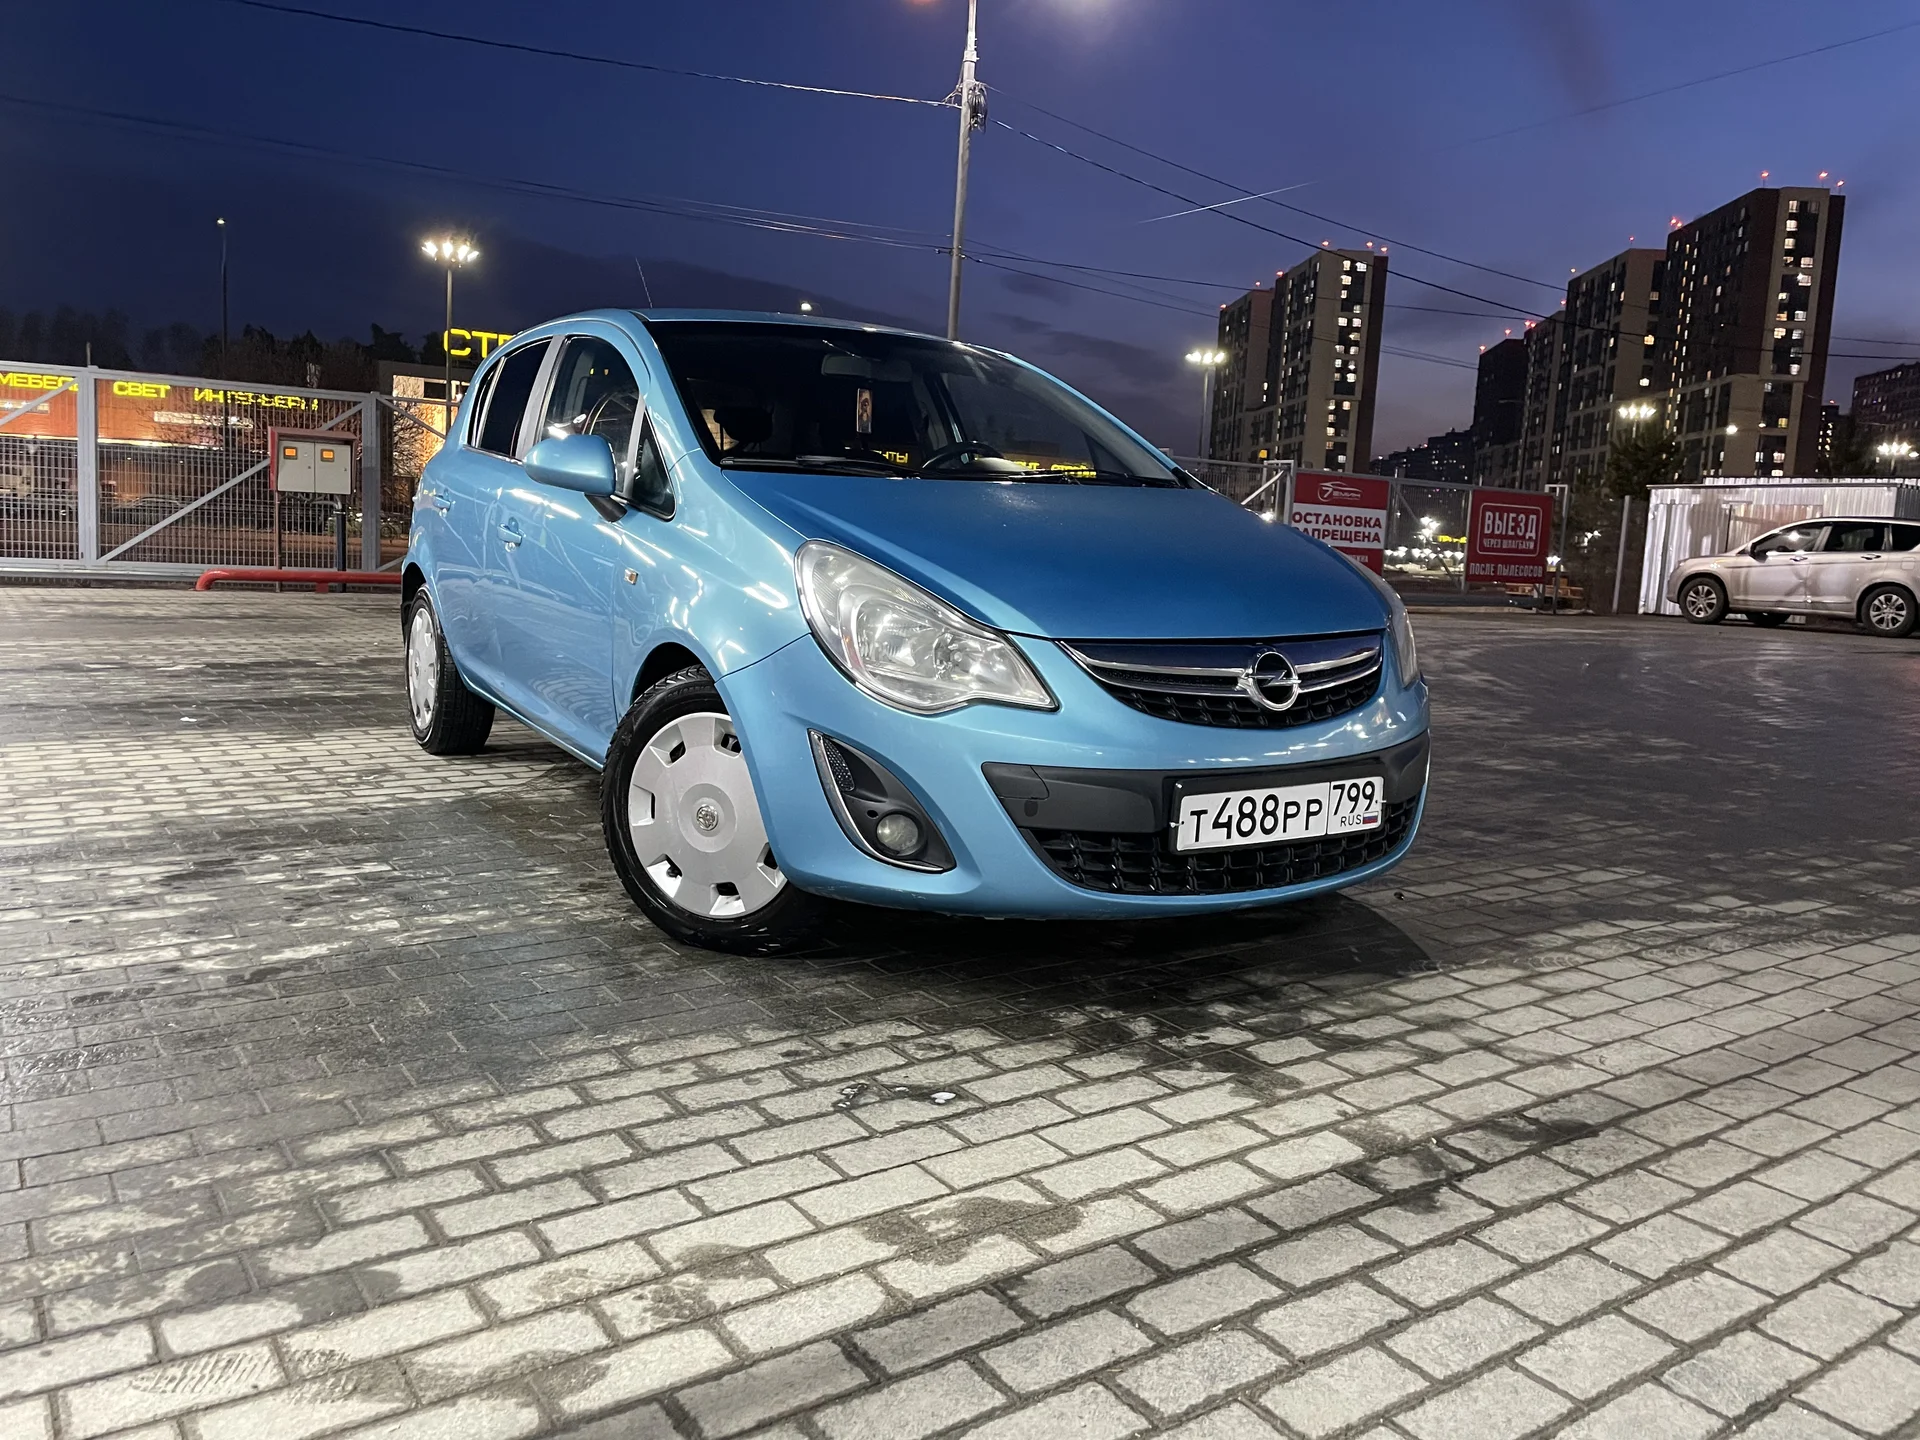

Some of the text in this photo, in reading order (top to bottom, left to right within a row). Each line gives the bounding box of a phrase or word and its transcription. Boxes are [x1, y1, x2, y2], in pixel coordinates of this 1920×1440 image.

[113, 381, 171, 398] СВЕТ
[1292, 511, 1382, 529] ОСТАНОВКА
[1483, 511, 1537, 540] ВЫЕЗД
[1469, 562, 1543, 577] ПОСЛЕ ПЫЛЕСОСОВ
[1332, 780, 1376, 816] 799
[1339, 815, 1362, 827] RUS
